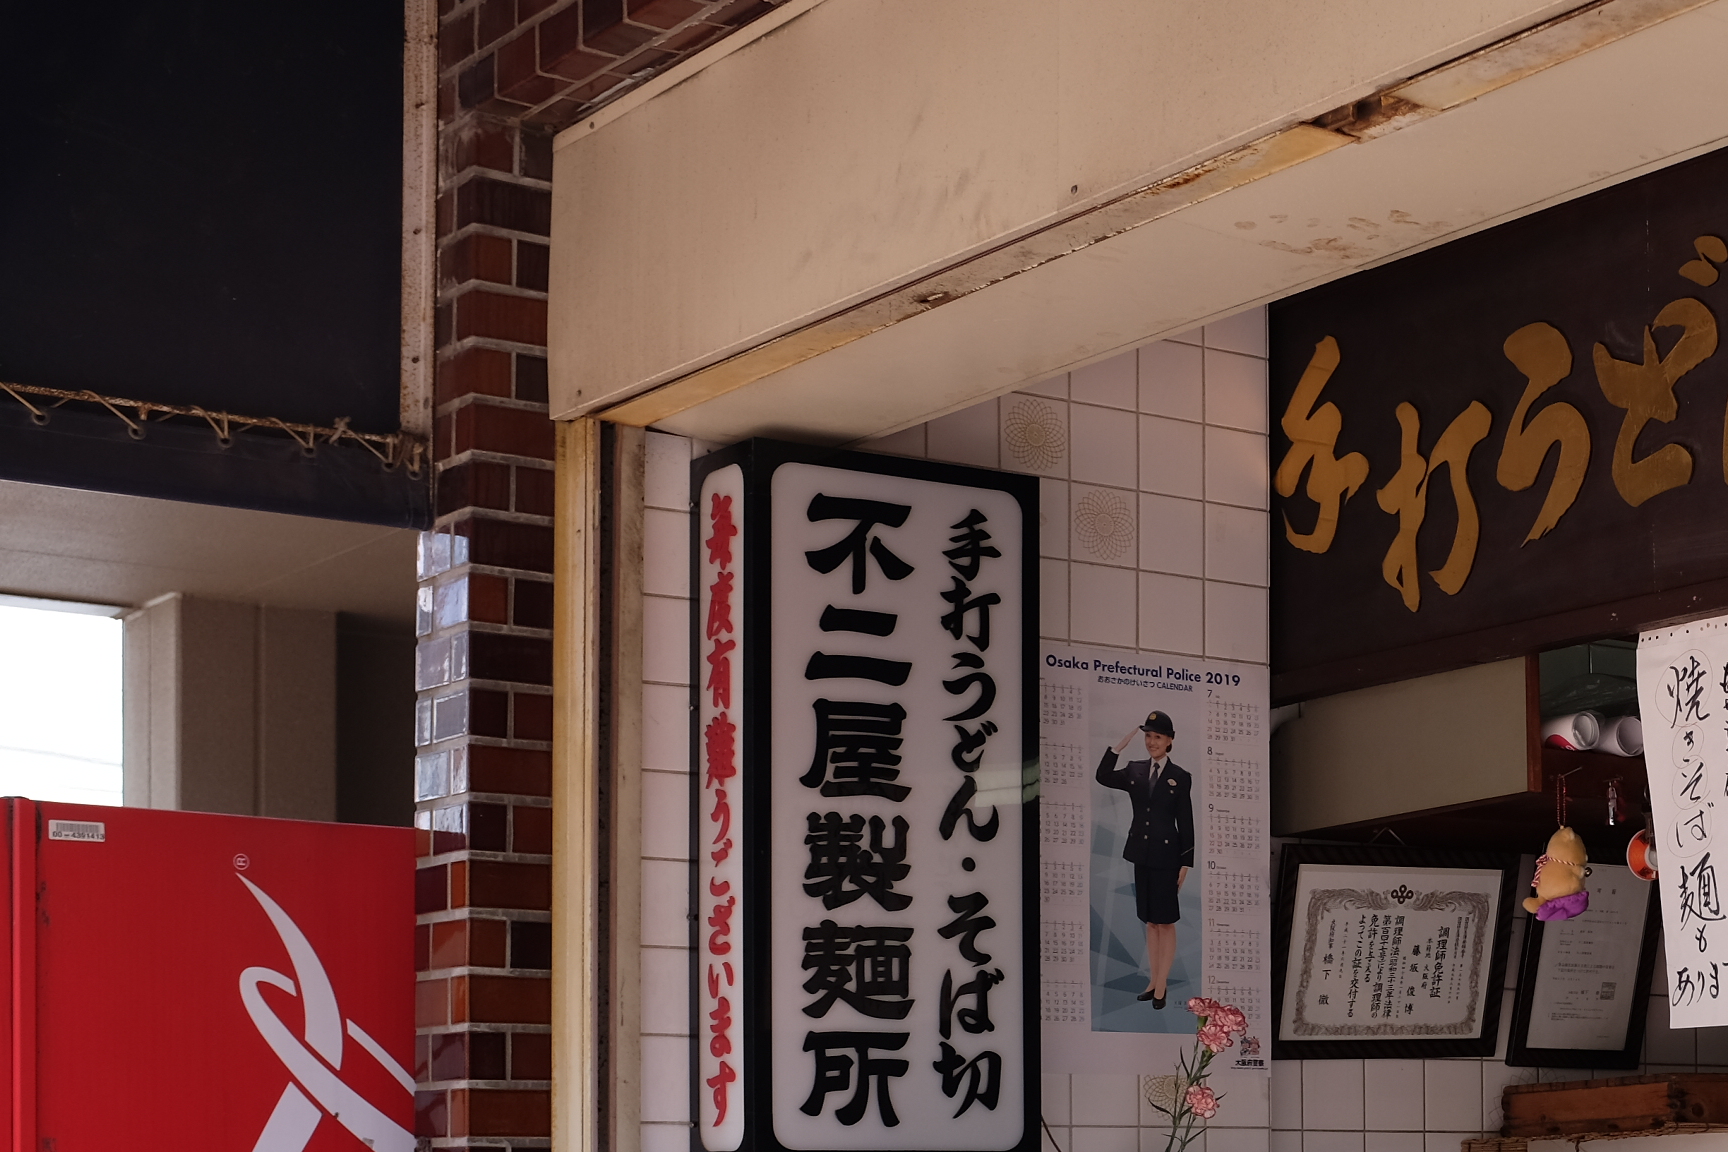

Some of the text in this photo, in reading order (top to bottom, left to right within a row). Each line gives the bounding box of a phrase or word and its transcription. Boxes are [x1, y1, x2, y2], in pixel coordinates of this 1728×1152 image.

[1045, 654, 1241, 687] Osaka Prefectural Police 2019
[1157, 681, 1193, 693] CALENDAR
[1207, 690, 1213, 698] 7
[1207, 746, 1213, 755] 8
[705, 492, 738, 1127] 毎度有難うございます
[1208, 803, 1214, 813] 9
[932, 508, 1004, 1119] 手打うどん・そば切
[1207, 861, 1216, 870] 10
[1208, 918, 1215, 927] 11
[1429, 926, 1450, 998] 調理師免許証
[1207, 975, 1216, 985] 12
